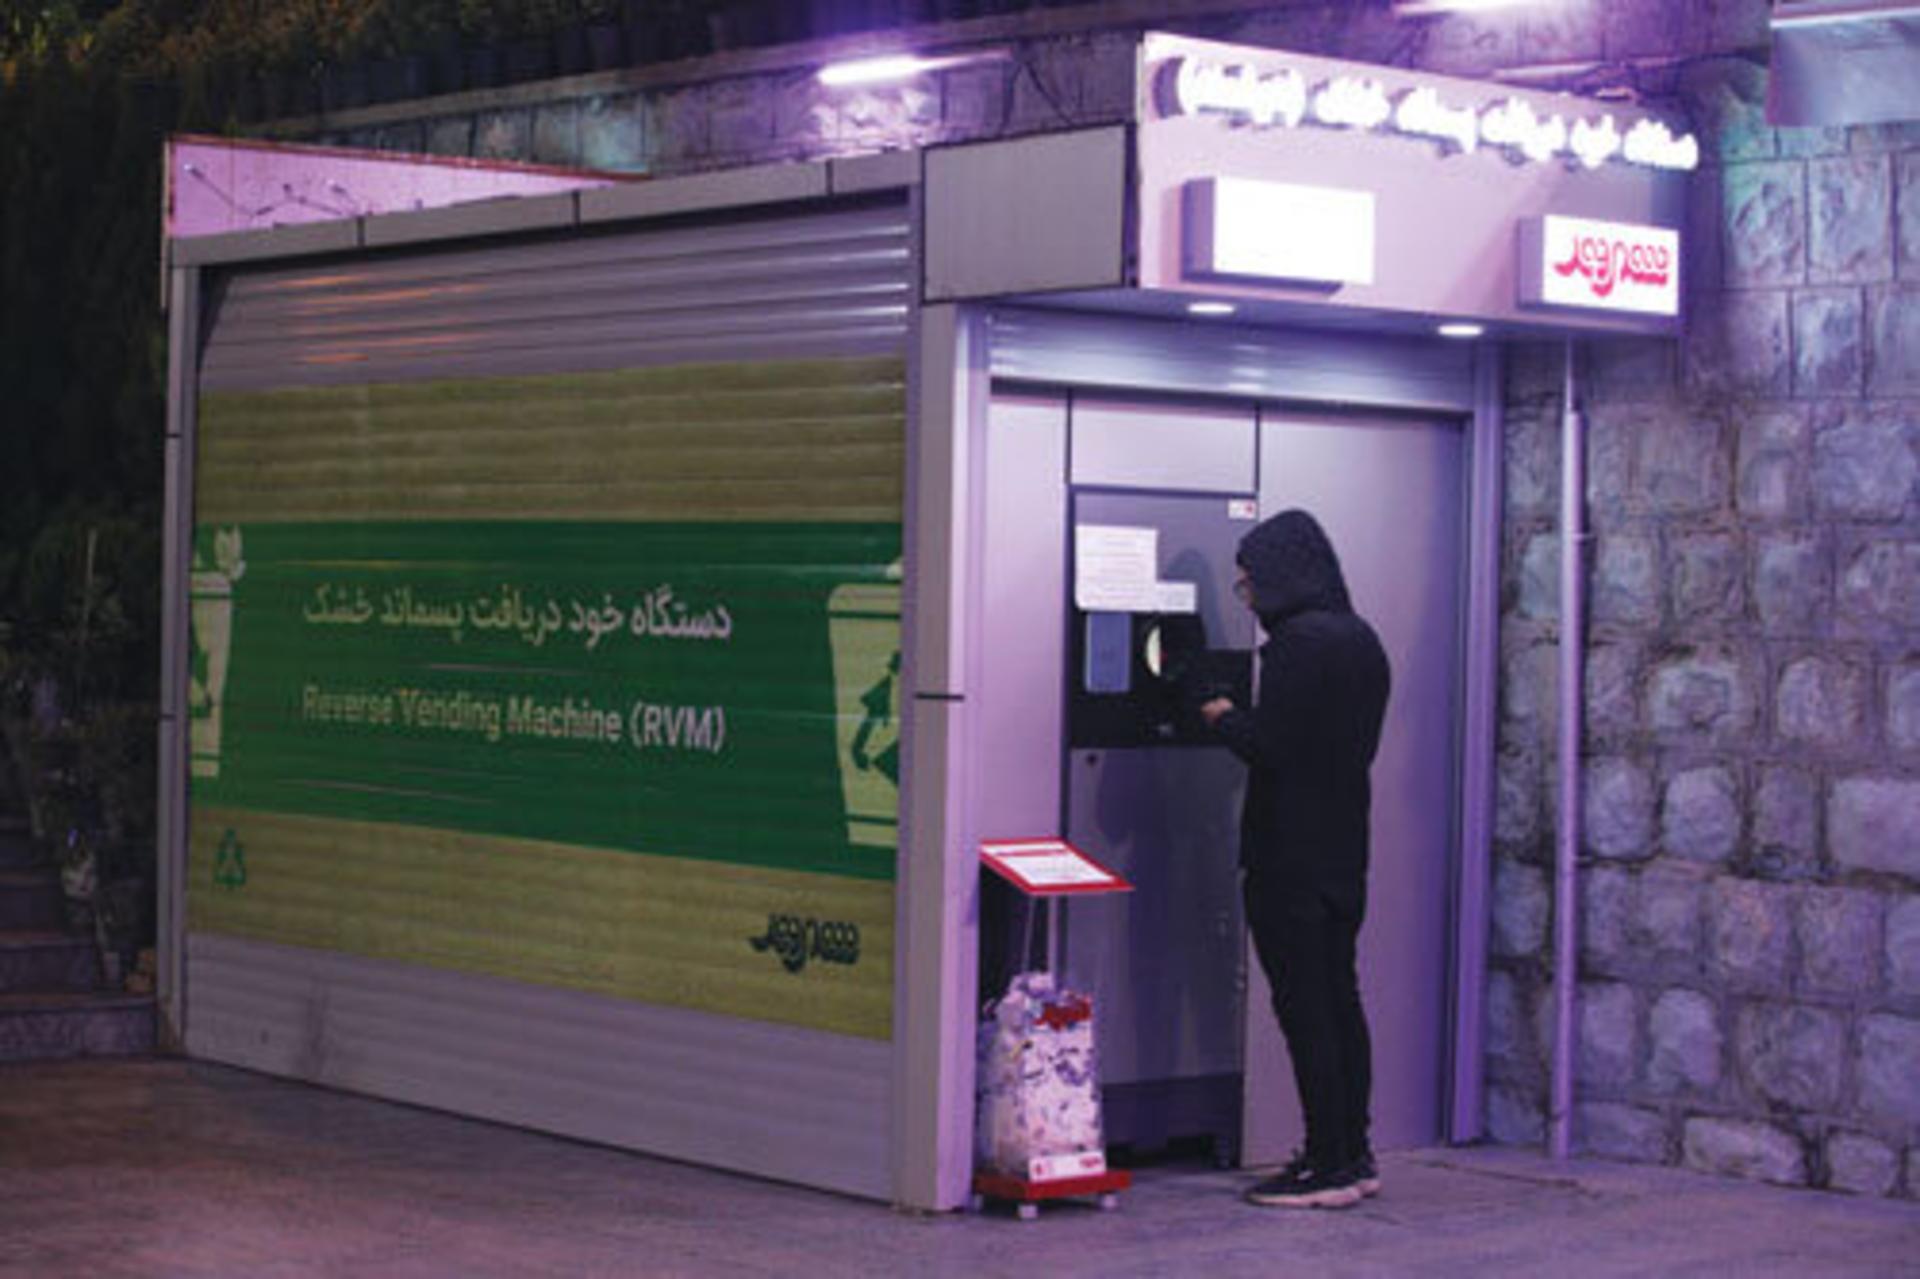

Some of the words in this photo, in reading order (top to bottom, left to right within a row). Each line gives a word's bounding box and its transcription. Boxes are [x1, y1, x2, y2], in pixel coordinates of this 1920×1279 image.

[303, 582, 374, 624] خشک
[380, 586, 465, 641] پسماند
[469, 584, 562, 646] دریافت
[570, 594, 624, 648] خود
[630, 584, 732, 639] دستگاه
[303, 686, 393, 724] Reverse
[399, 688, 500, 741] Vending
[506, 697, 622, 740] Machine
[629, 701, 726, 751] (RVM)
